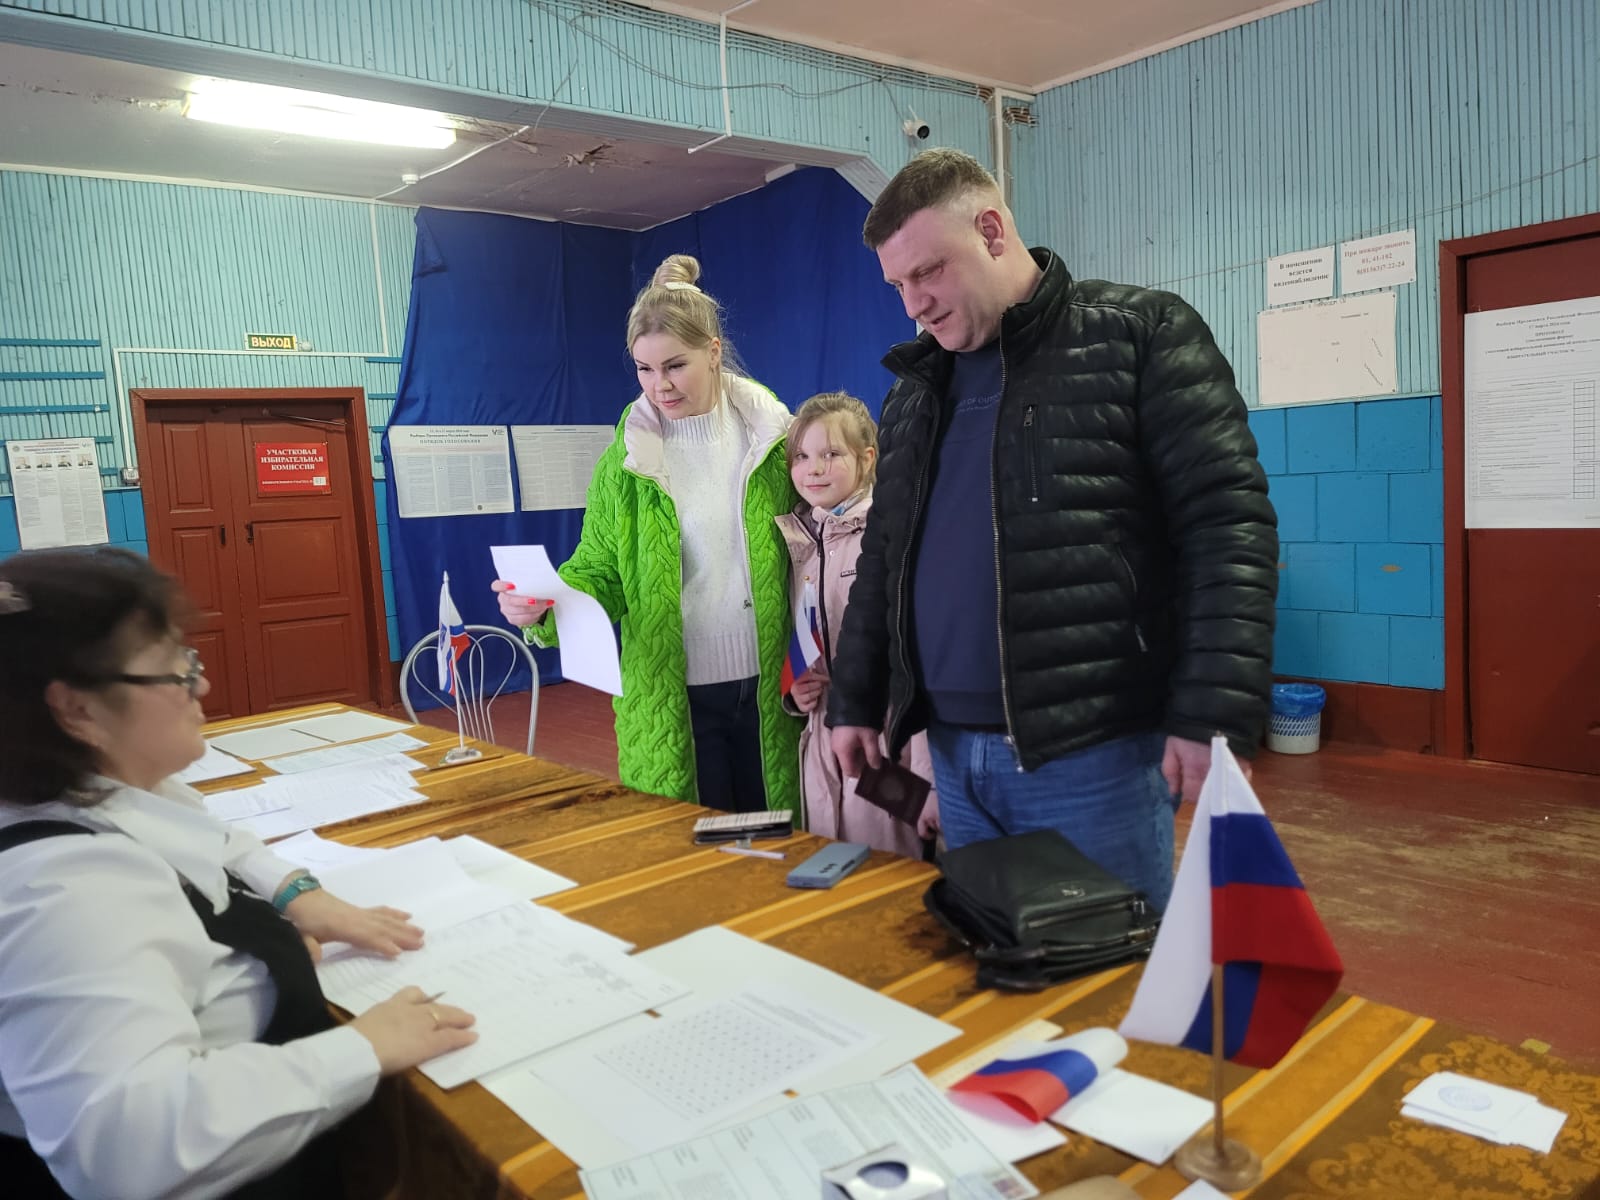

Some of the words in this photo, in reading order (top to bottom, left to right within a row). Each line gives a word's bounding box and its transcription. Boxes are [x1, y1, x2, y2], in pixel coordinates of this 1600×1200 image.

[251, 336, 291, 349] ВЫХОД
[266, 448, 317, 456] УЧАСТКОВАЯ
[260, 455, 324, 464] ИЗБИРАТЕЛЬНАЯ
[271, 463, 315, 471] КОМИССИЯ
